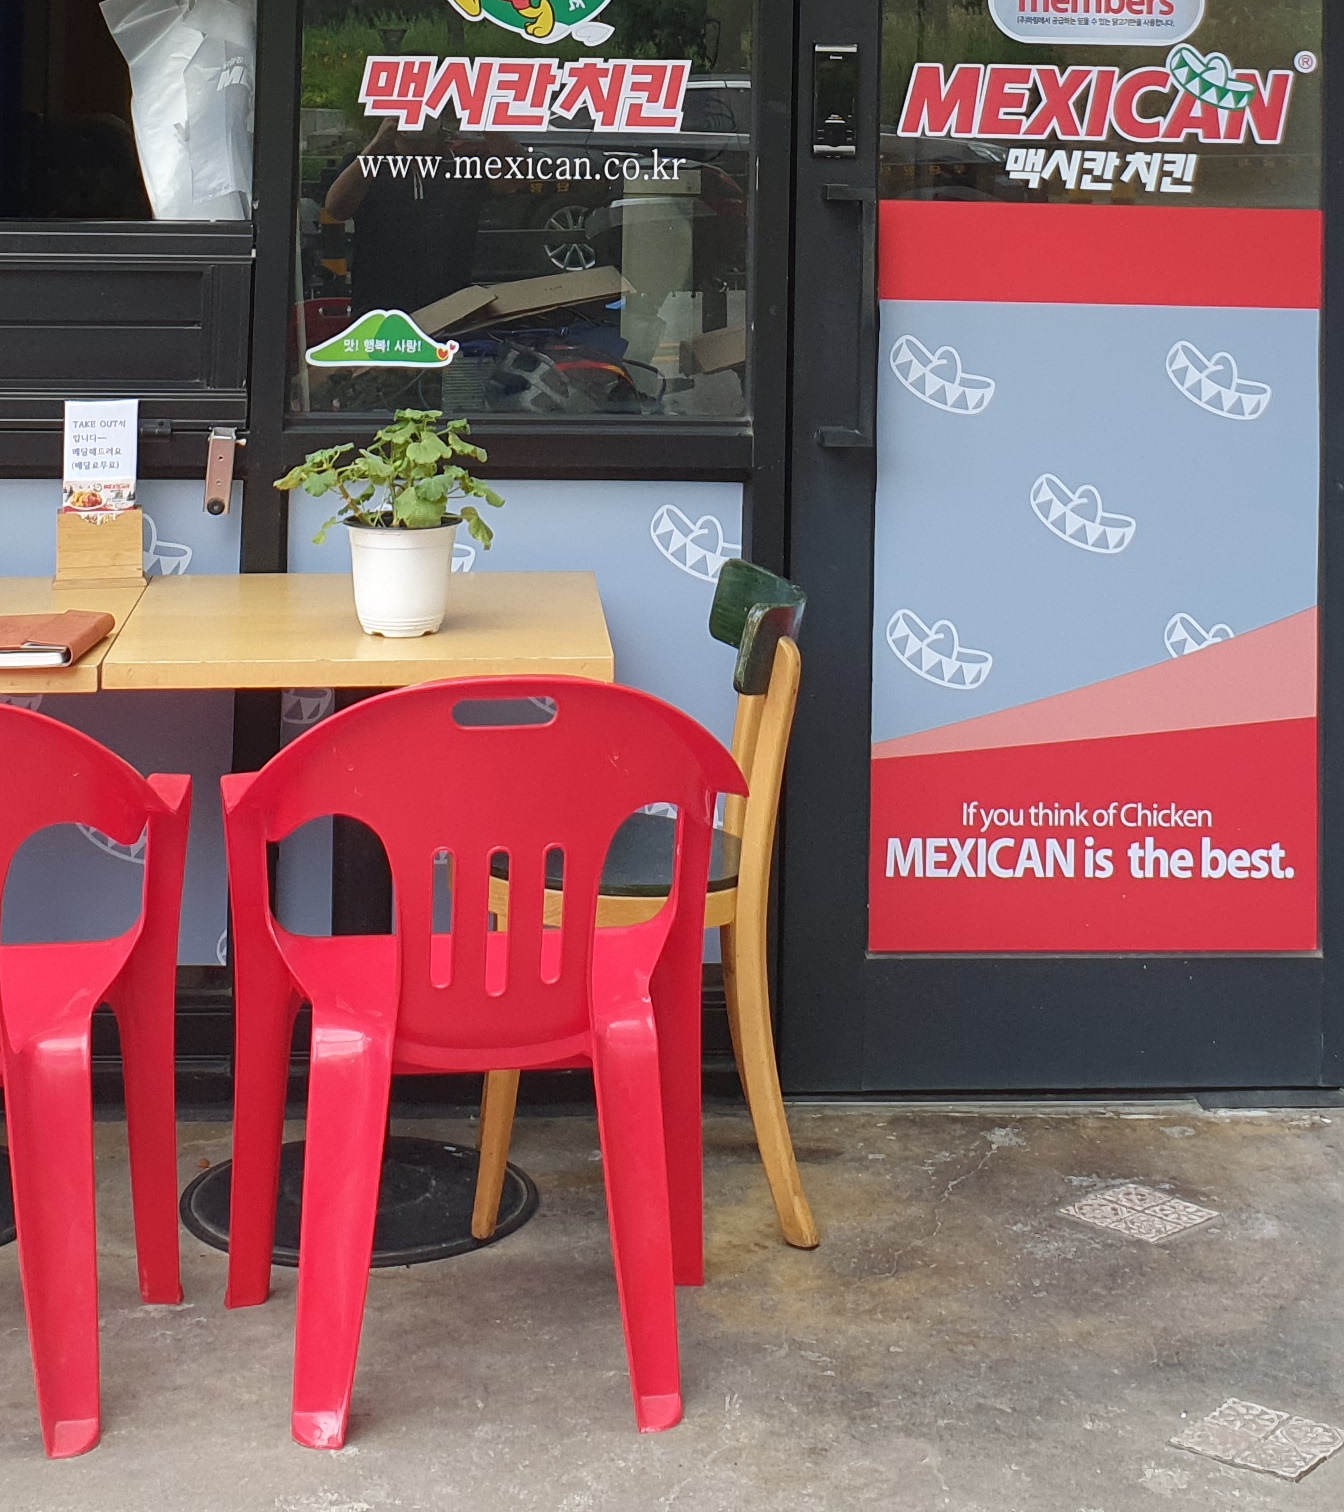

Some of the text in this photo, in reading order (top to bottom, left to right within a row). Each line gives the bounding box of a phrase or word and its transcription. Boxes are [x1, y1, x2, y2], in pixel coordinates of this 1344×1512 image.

[899, 64, 1293, 143] MEXICAN
[356, 147, 687, 181] www.mexican.co.kr
[343, 339, 359, 353] 맛!
[394, 339, 422, 354] 사랑!
[72, 420, 97, 429] TAKE
[962, 801, 1212, 832] If you think of Chicken
[885, 836, 1295, 879] MEXICAN is the best.
